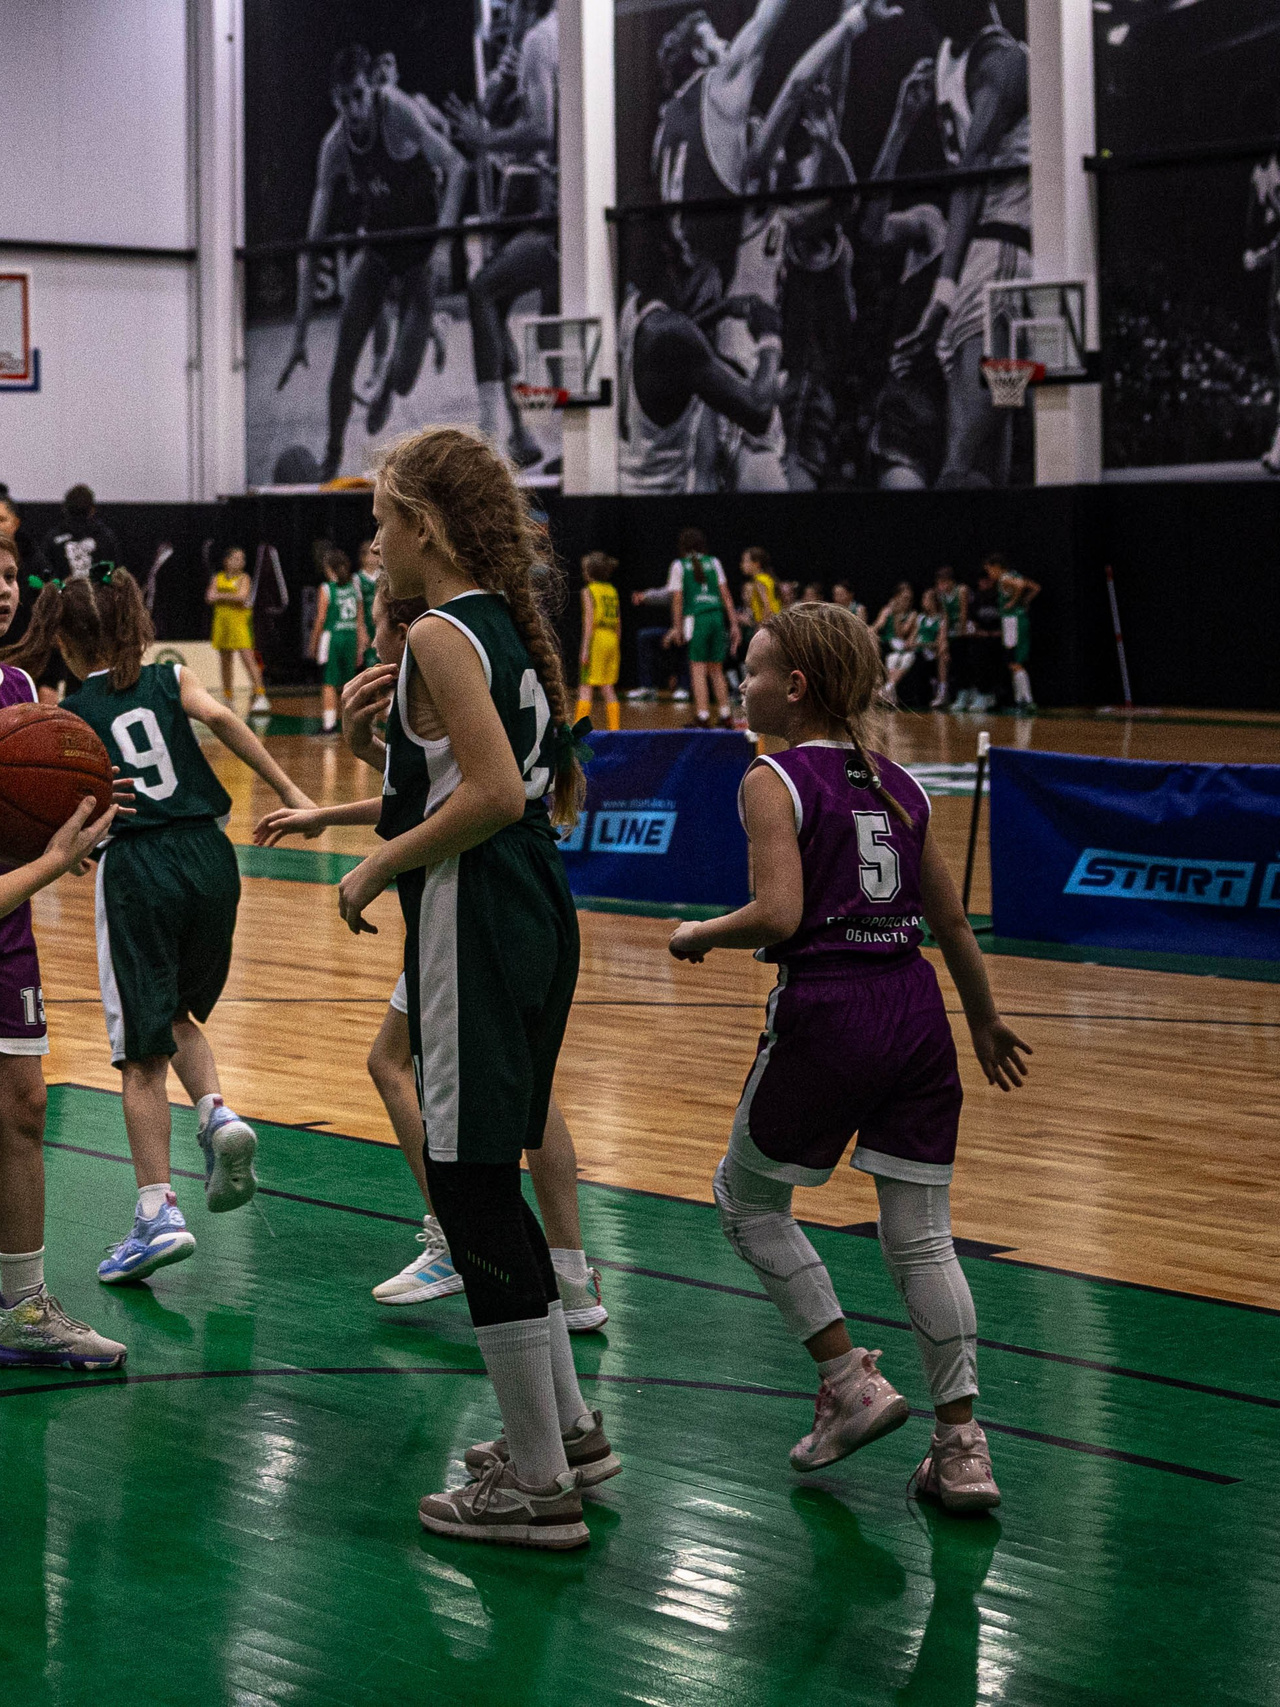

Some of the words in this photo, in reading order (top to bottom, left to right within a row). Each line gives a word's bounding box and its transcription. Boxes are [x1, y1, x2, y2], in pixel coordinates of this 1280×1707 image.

[110, 706, 178, 801] 9
[846, 769, 868, 779] РФБ
[599, 818, 666, 846] LINE
[852, 810, 901, 903] 5
[1078, 857, 1245, 898] START
[826, 915, 924, 929] БОРОДСКА
[845, 928, 909, 944] ОБЛАСТЬ
